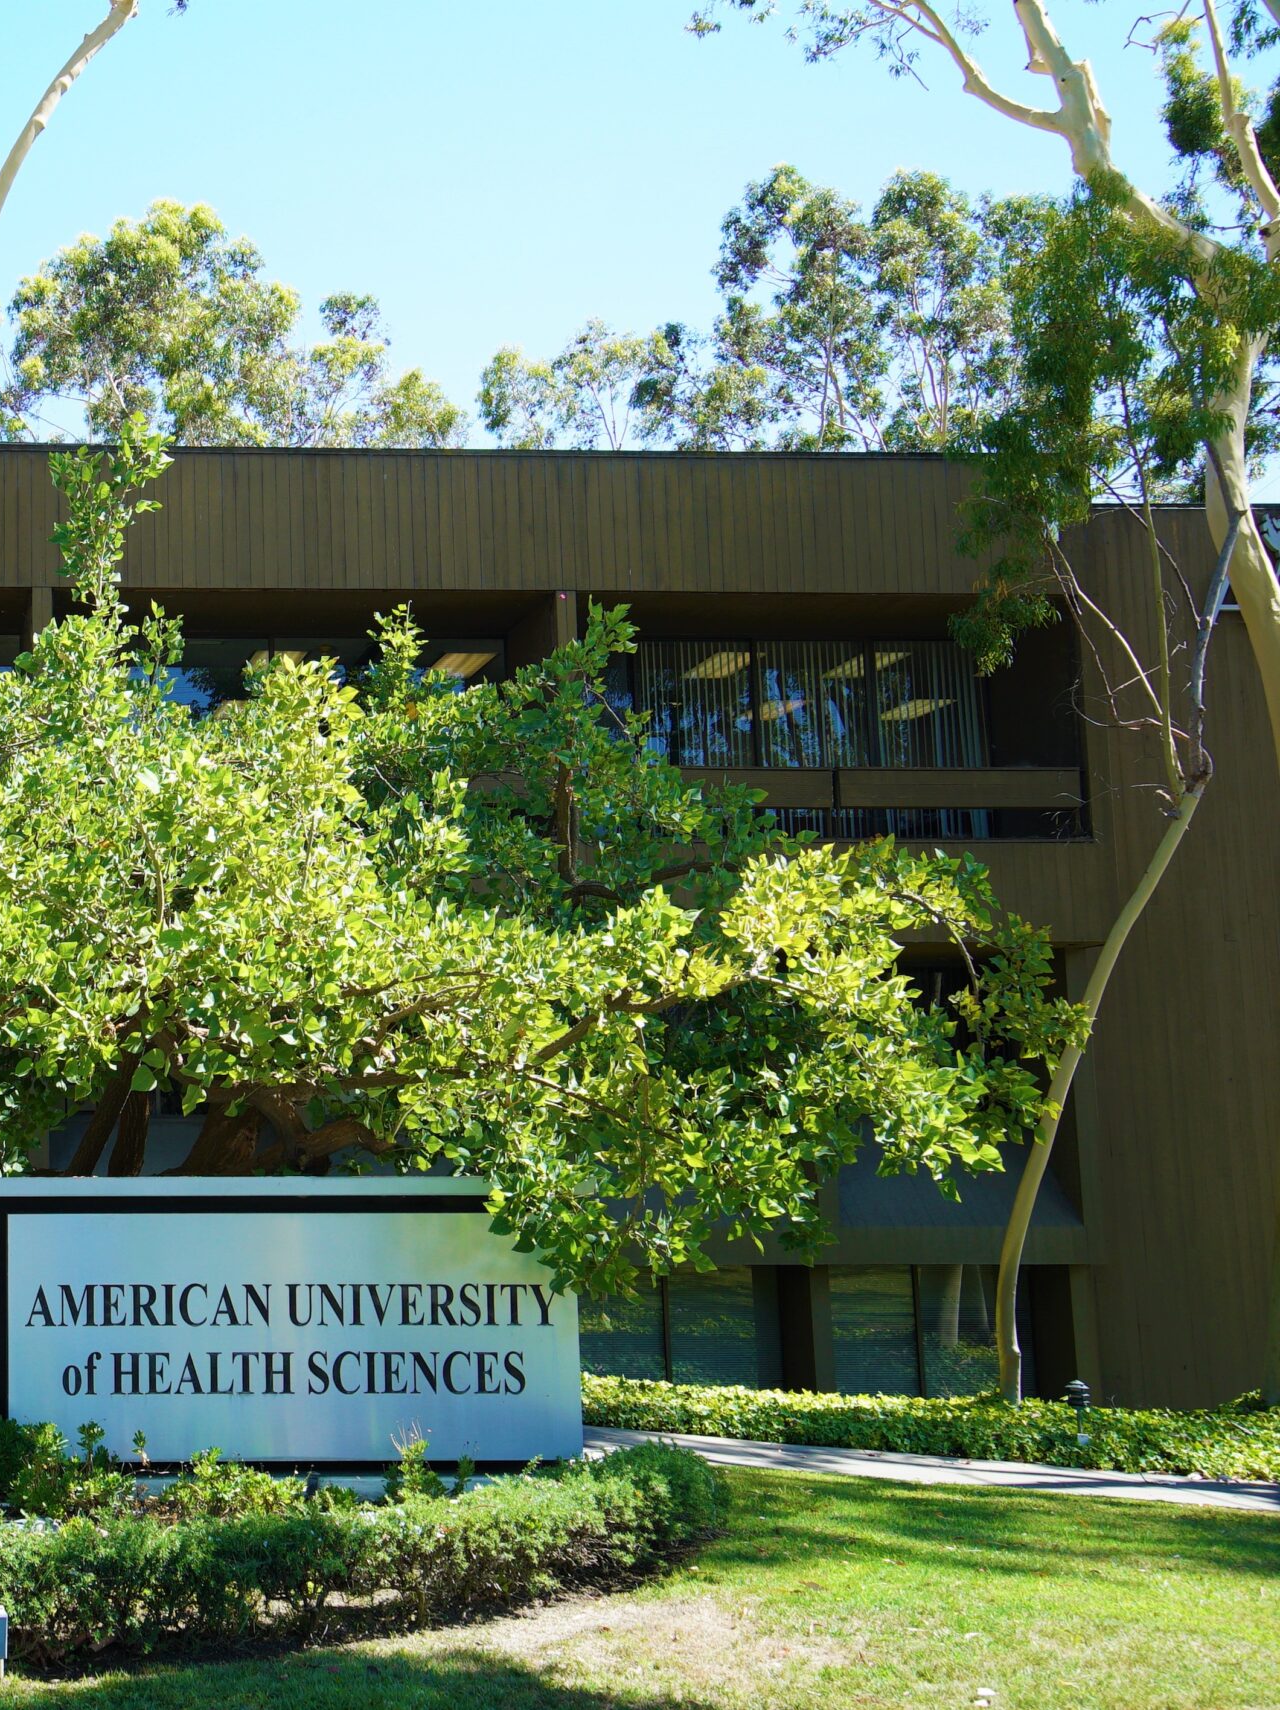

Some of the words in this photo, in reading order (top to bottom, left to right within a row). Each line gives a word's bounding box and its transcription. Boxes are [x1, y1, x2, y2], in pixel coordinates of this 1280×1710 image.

[25, 1283, 271, 1327] AMERICAN
[284, 1283, 556, 1327] UNIVERSITY
[62, 1351, 102, 1396] of
[110, 1352, 295, 1395] HEALTH
[307, 1350, 527, 1396] SCIENCES
